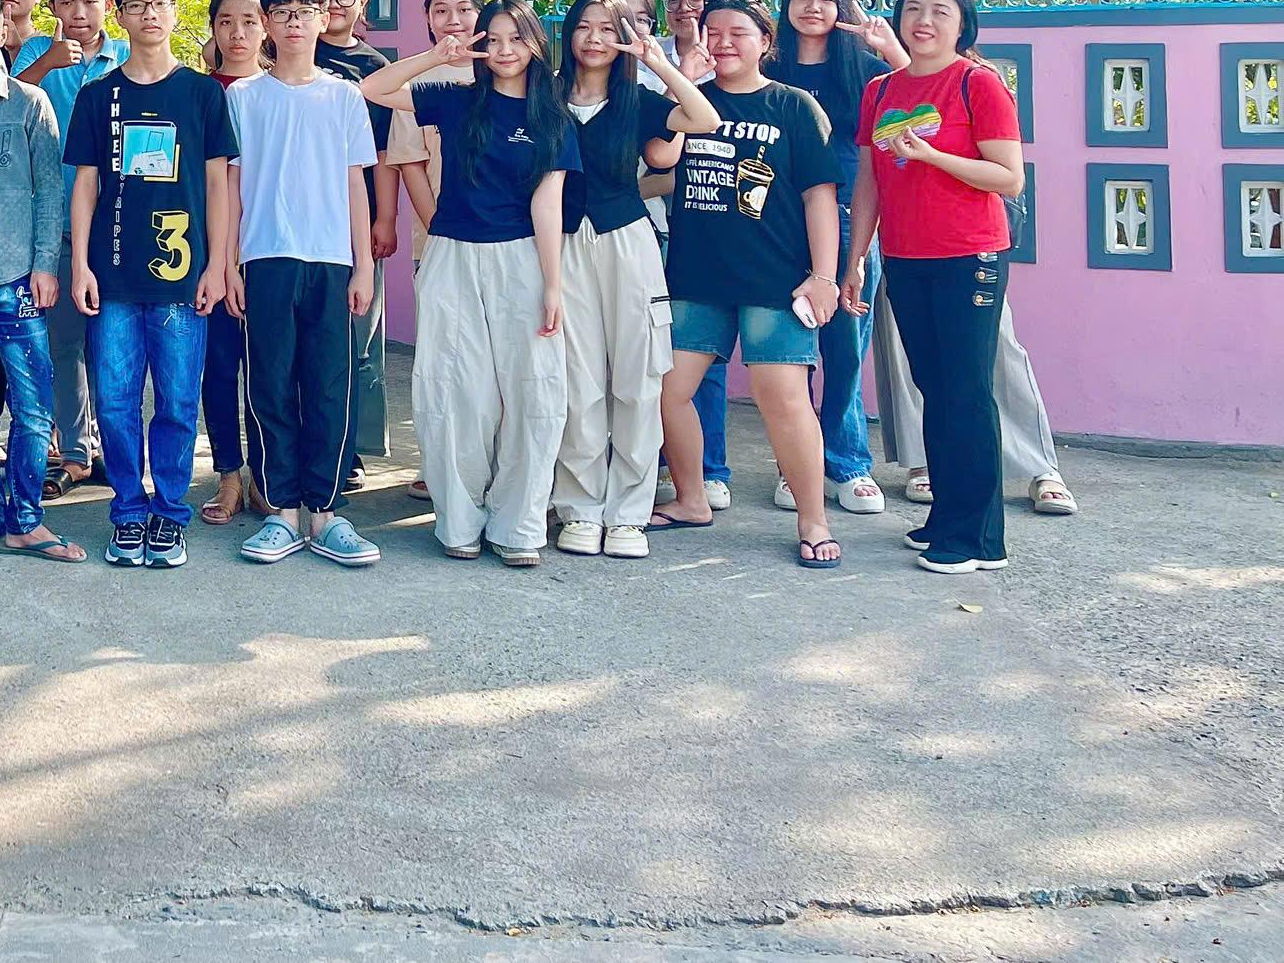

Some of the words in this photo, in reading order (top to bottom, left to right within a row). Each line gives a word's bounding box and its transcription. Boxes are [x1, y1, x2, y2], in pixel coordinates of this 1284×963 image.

[110, 87, 121, 172] THREE
[734, 121, 781, 145] STOP
[148, 210, 192, 282] 3
